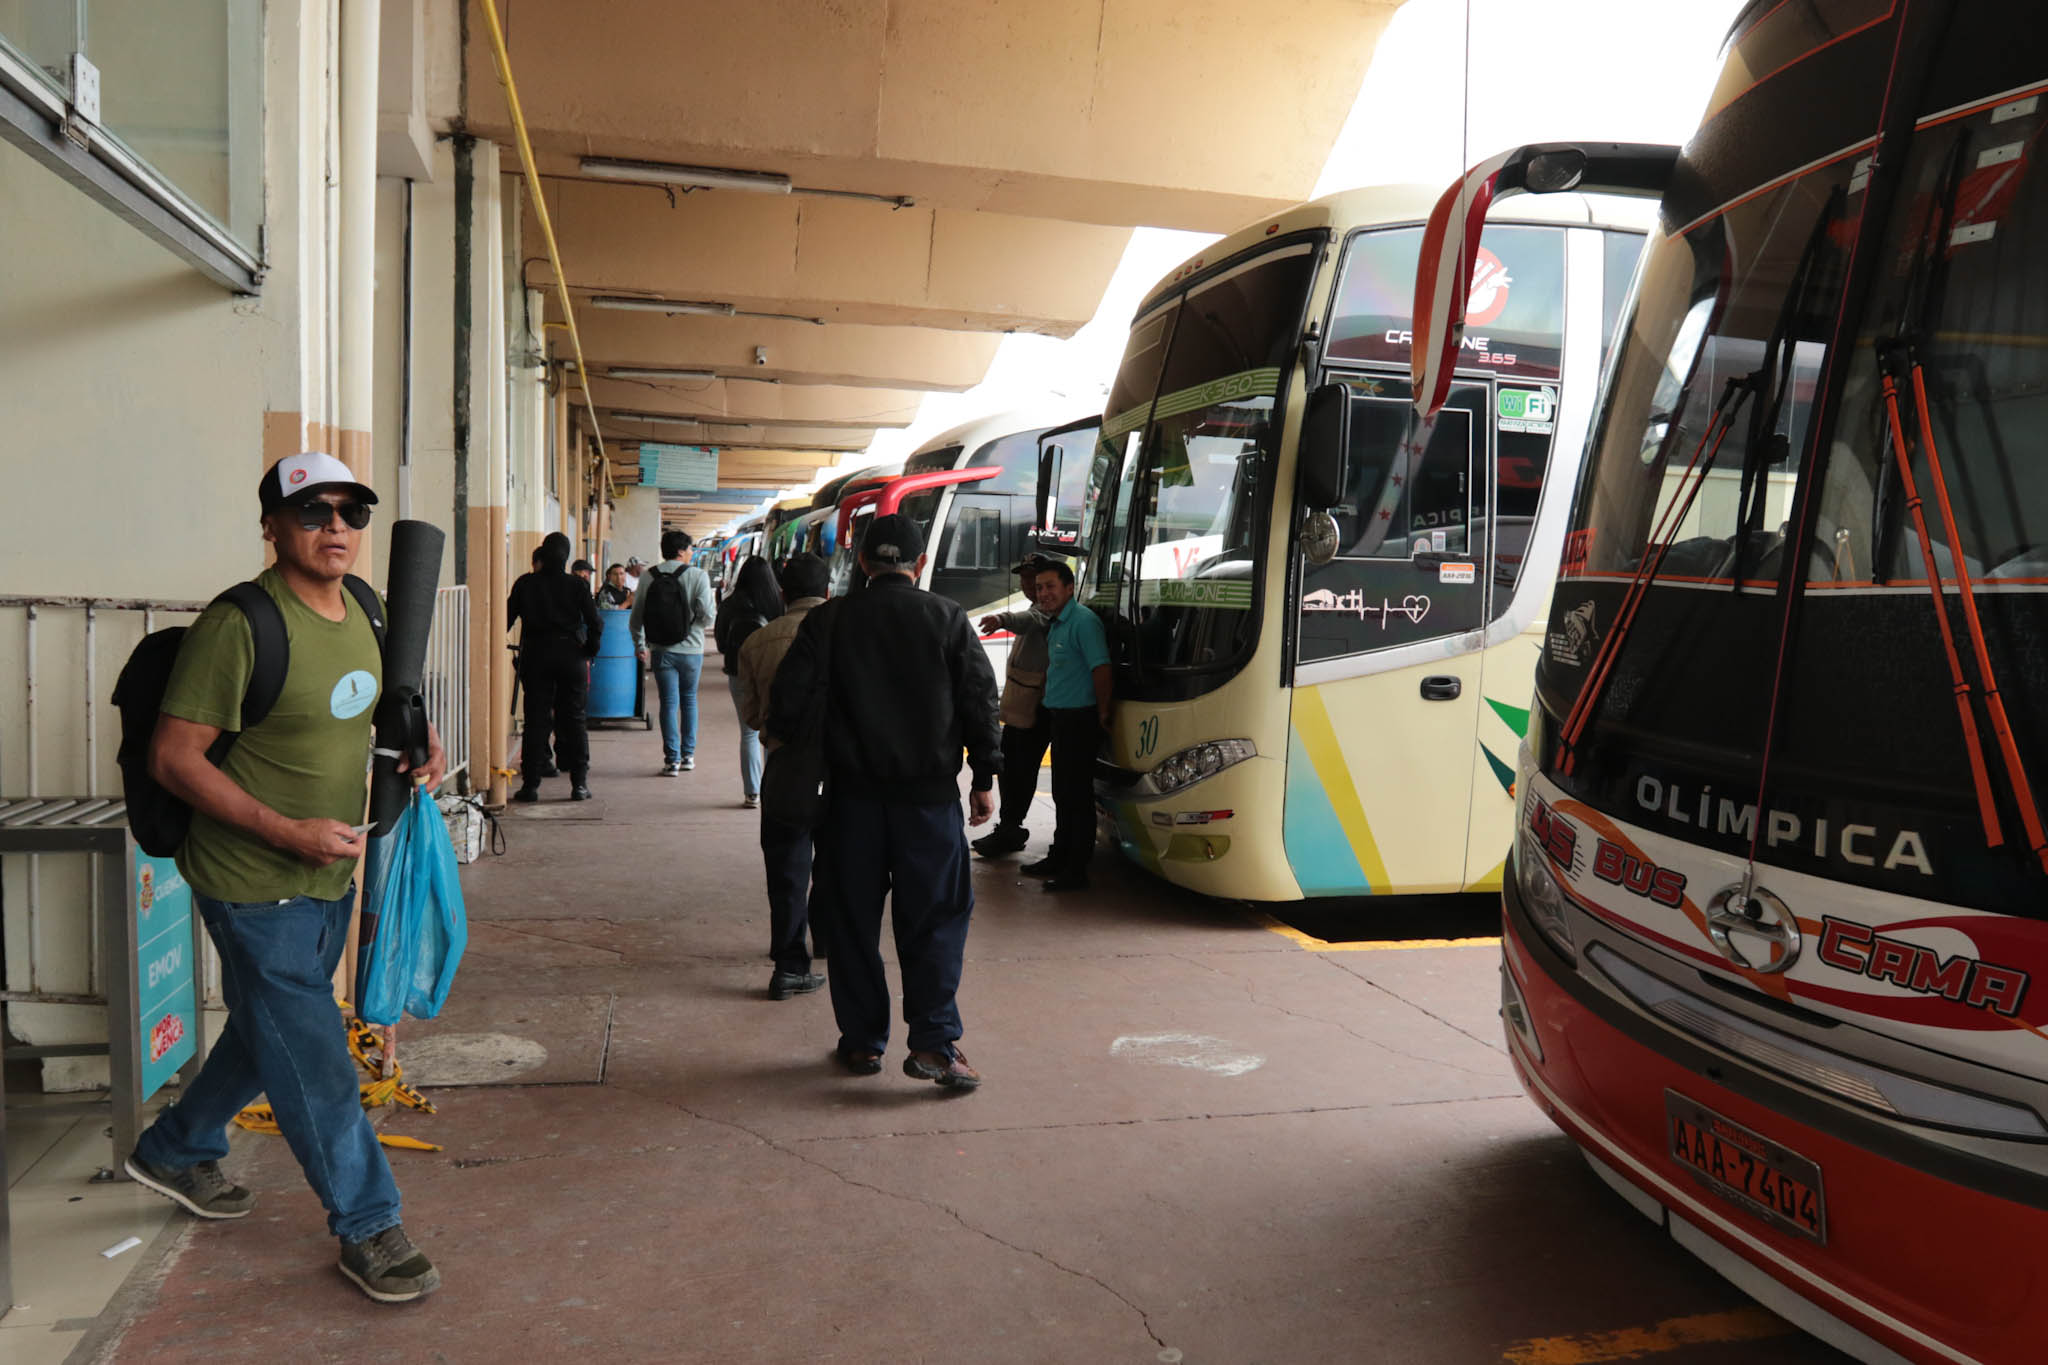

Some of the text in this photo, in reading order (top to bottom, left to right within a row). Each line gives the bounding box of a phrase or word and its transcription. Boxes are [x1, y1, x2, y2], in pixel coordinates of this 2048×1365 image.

[1385, 329, 1490, 351] CANE
[1200, 375, 1252, 401] K-360
[1160, 583, 1226, 601] CAMPIONE
[1136, 715, 1158, 759] 30
[1636, 775, 1934, 875] OLÍMPICA
[1593, 837, 1687, 909] BUS
[1817, 914, 2031, 1018] CAMA
[148, 943, 182, 988] EMOV
[1676, 1119, 1817, 1230] AAA-7404
